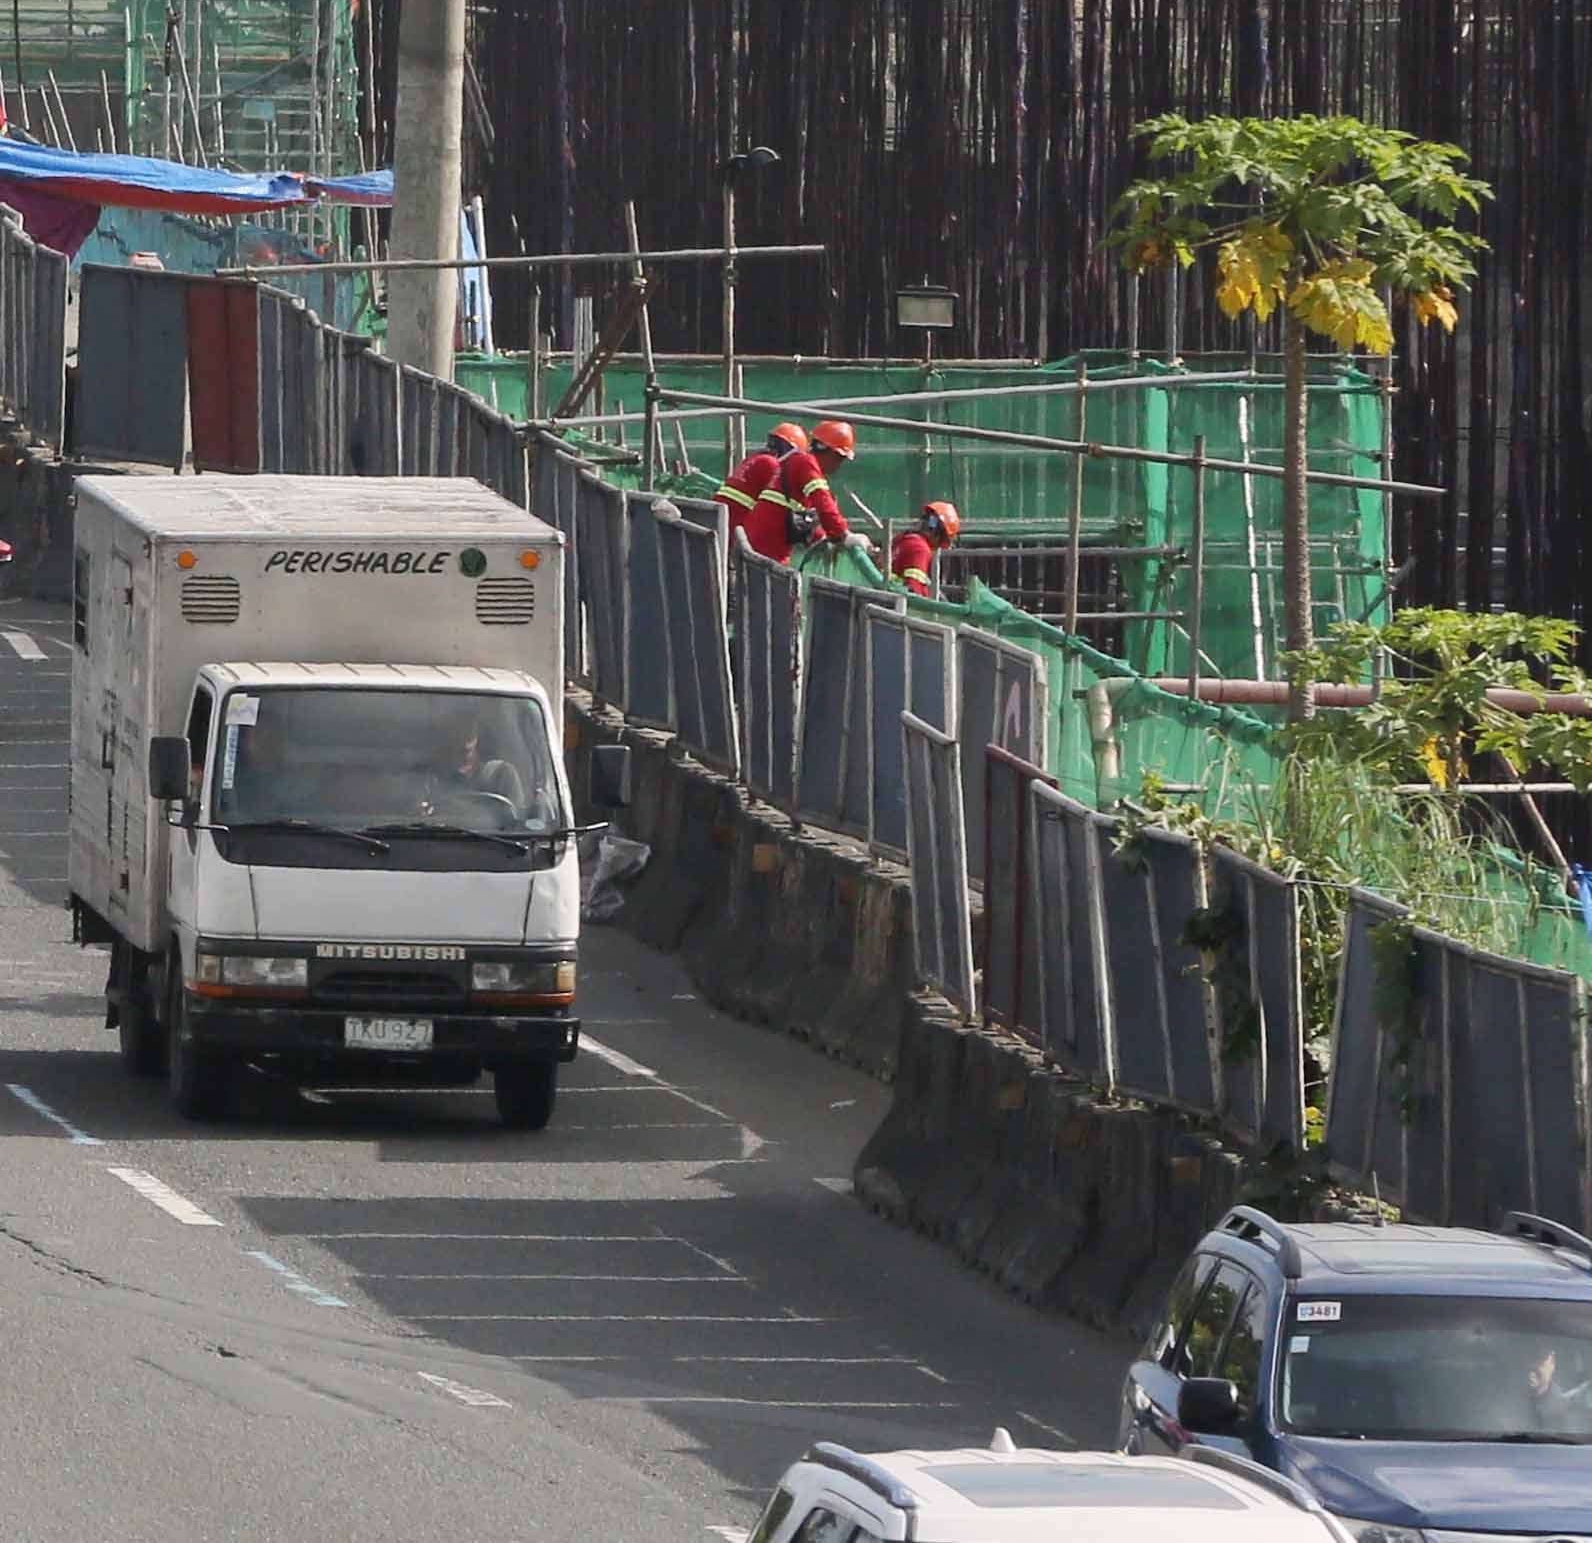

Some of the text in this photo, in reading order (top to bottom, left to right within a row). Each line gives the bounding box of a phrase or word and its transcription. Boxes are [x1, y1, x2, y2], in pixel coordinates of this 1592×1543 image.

[264, 550, 451, 574] PERISHABLE
[316, 944, 466, 961] MITSUBISHI
[348, 1019, 429, 1041] TKU 927
